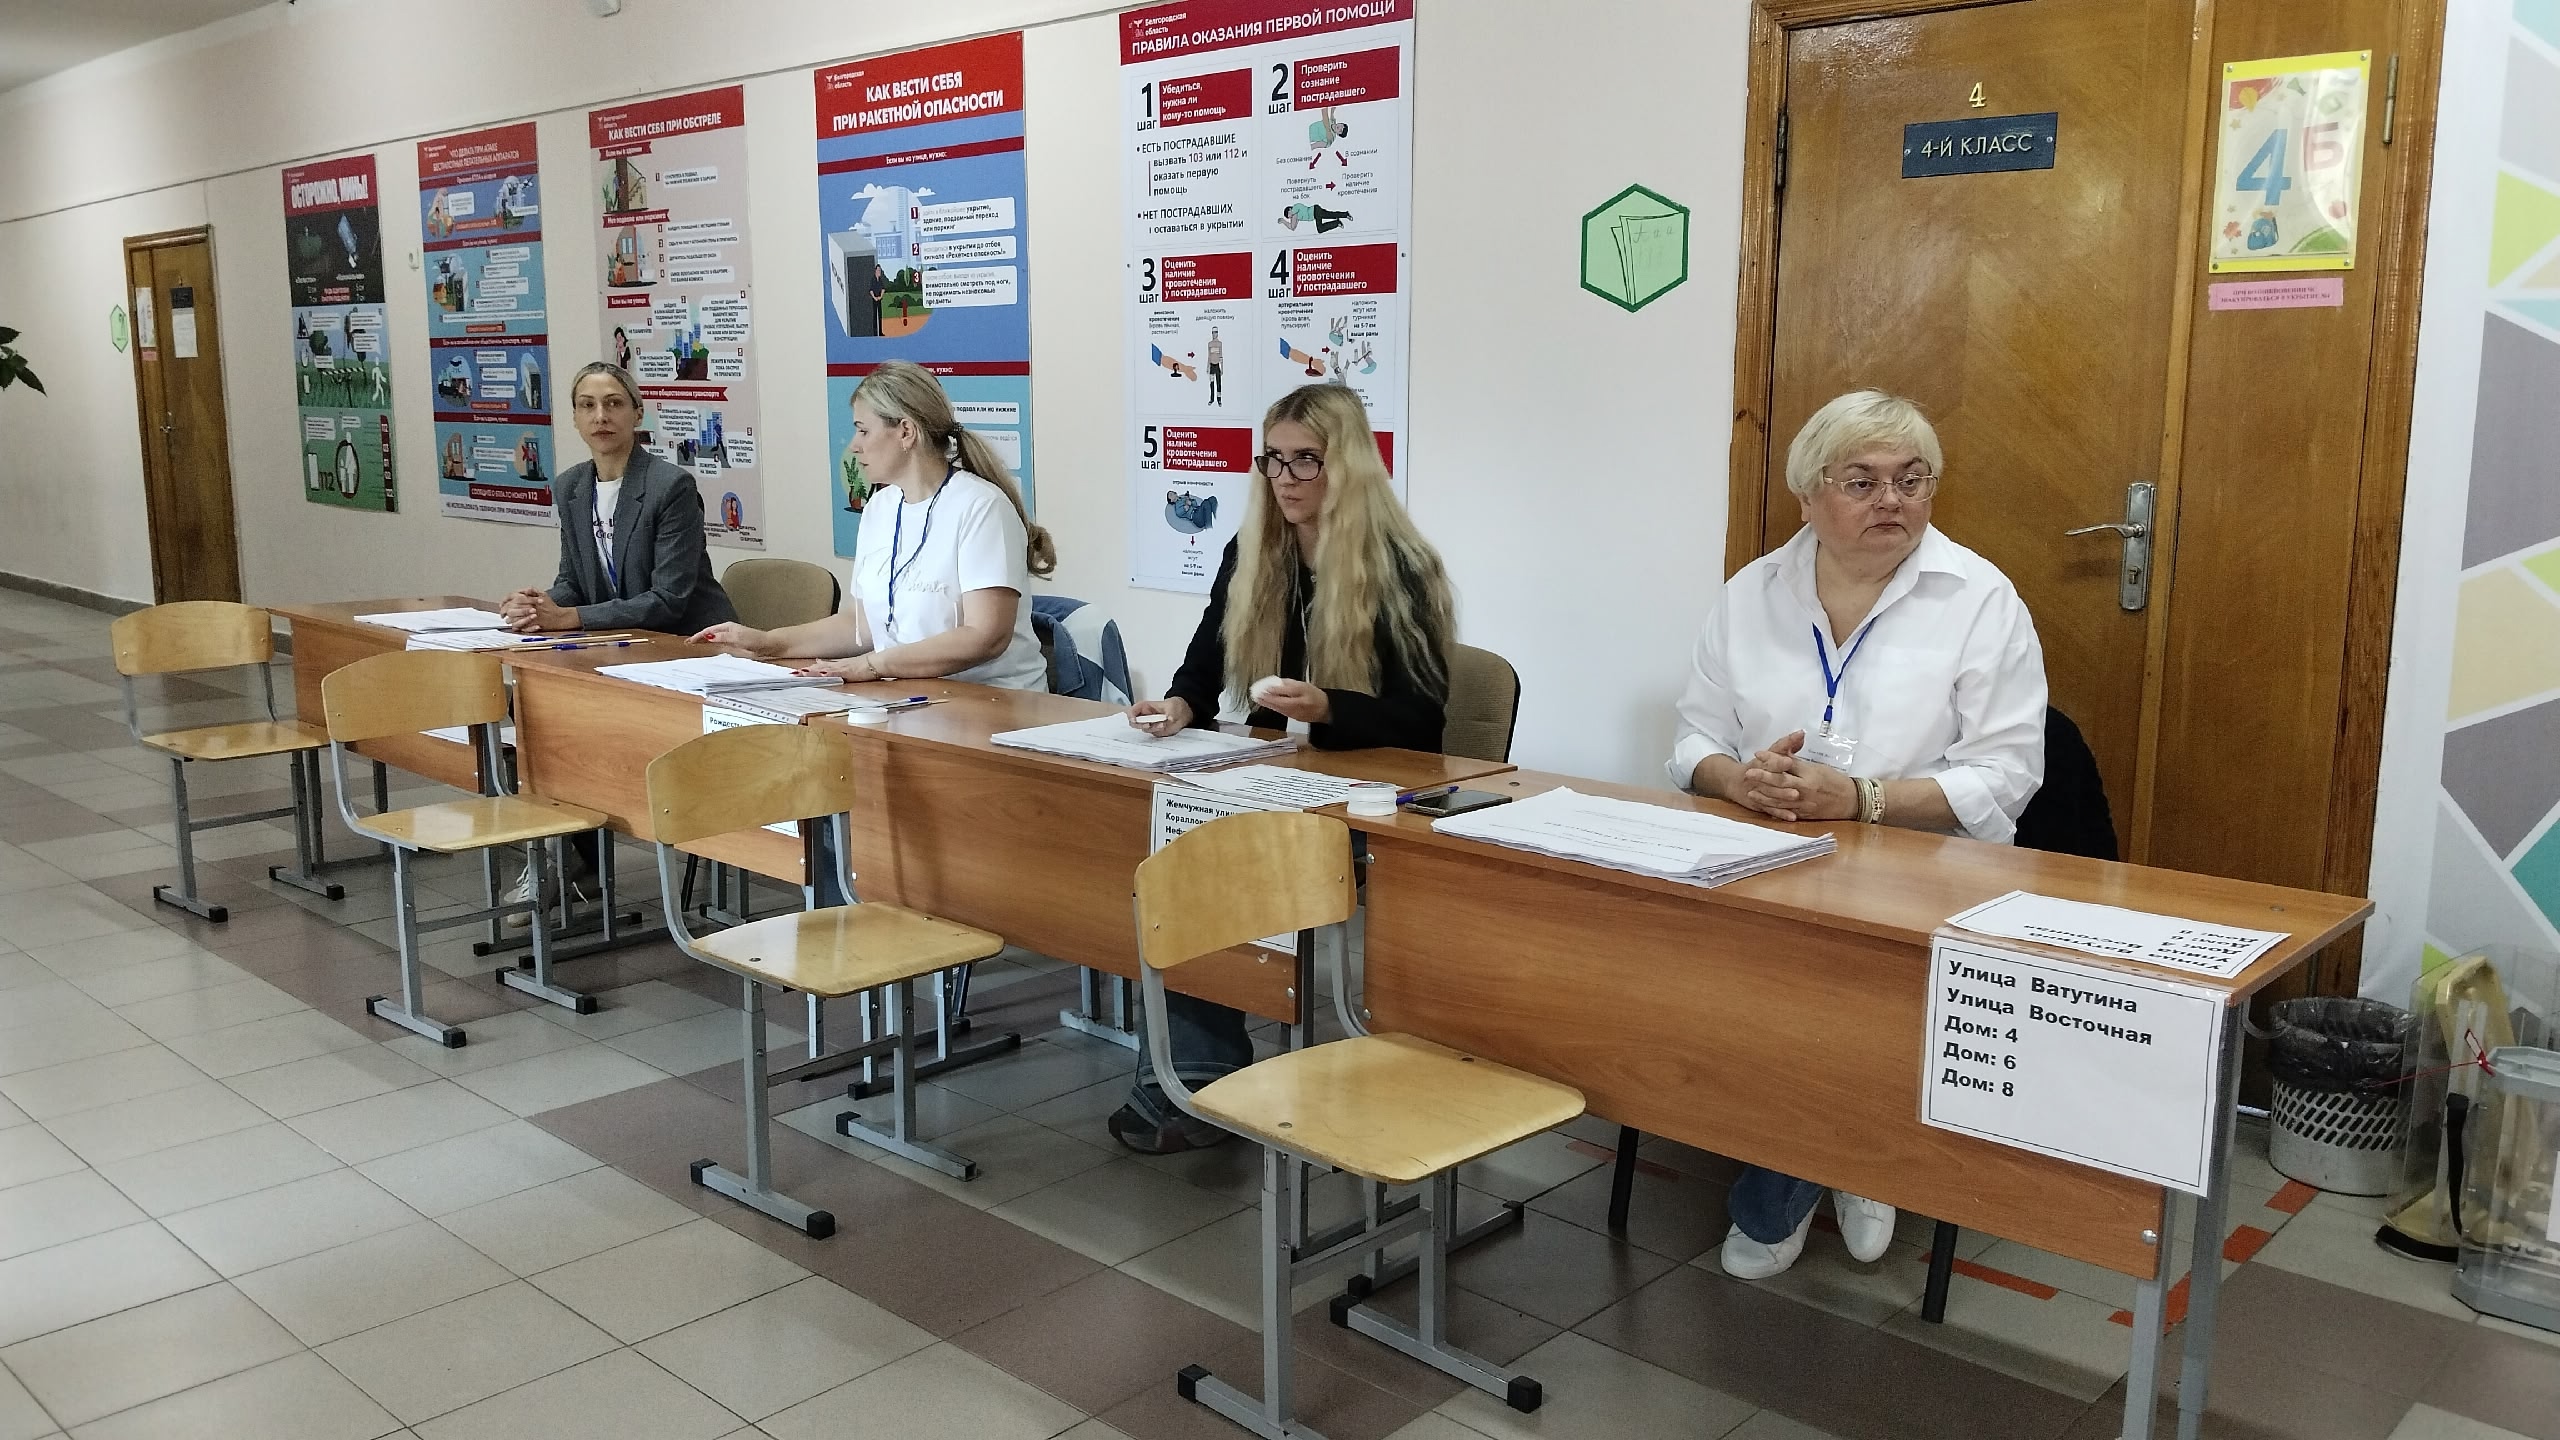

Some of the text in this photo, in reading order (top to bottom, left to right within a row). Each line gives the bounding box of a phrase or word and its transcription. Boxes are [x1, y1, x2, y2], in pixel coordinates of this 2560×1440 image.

[1132, 1, 1395, 56] ПРАВИЛА ОКАЗАНИЯ ПЕРВОЙ ПОМОЩИ
[1301, 61, 1348, 78] Проверить
[867, 71, 962, 102] КАК ВЕСТИ СЕБЯ
[1162, 82, 1203, 96] Убедиться,
[1272, 64, 1288, 101] 2
[1301, 76, 1340, 88] сознание
[1141, 82, 1151, 118] 1
[1162, 96, 1198, 108] нужна ли
[1301, 87, 1366, 104] пострадавшего
[1969, 81, 1986, 108] 4
[833, 90, 1003, 131] ПРИ РАКЕТНОЙ ОПАСНОСТИ
[1162, 106, 1226, 122] кому-то помощь
[1269, 102, 1292, 115] шаг
[609, 112, 721, 140] КАК ВЕСТИ СЕБЯ ПРИ ОБСТРЕЛЕ
[1136, 120, 1157, 131] шаг
[1142, 133, 1236, 154] ЕСТЬ ПОСТРАДАВШИЕ
[1921, 133, 2033, 158] 4-Й КЛАСС
[1154, 148, 1247, 167] вызвать 103 или 112 и
[1154, 167, 1219, 182] оказать первую
[2236, 128, 2292, 206] 4
[1154, 186, 1187, 196] помощь
[1143, 203, 1233, 220] НЕТ ПОСТРАДАВШИХ
[1154, 223, 1197, 233] оставаться
[1207, 220, 1244, 232] укрытии
[1165, 259, 1196, 269] Оценить
[1297, 251, 1332, 262] Оценить
[1165, 269, 1195, 278] наличие
[1269, 250, 1289, 285] 4
[1297, 261, 1332, 272] наличие
[1142, 258, 1156, 291] 3
[1297, 270, 1355, 283] кровотечения
[1165, 278, 1216, 289] кровотечения
[1297, 280, 1367, 293] у пострадавшего
[1139, 292, 1159, 303] шаг
[1165, 286, 1227, 298] у пострадавшего
[1268, 288, 1291, 299] шаг
[1144, 426, 1157, 457] 5
[1166, 429, 1197, 439] Оценить
[1166, 439, 1196, 448] наличие
[1167, 448, 1217, 459] кровотечения
[1141, 459, 1161, 471] шаг
[1166, 457, 1228, 469] у пострадавшего
[528, 491, 538, 500] 112
[1166, 798, 1213, 814] Жемчужная
[2149, 953, 2220, 970] Улица
[2158, 948, 2231, 962] Улица
[1948, 960, 2138, 1014] Улица Ватутина
[1947, 988, 2152, 1046] Улица Восточная
[1944, 1014, 2018, 1044] Дом: 4
[1943, 1042, 2017, 1070] Дом: 6
[1942, 1068, 2014, 1098] Дом: 8
